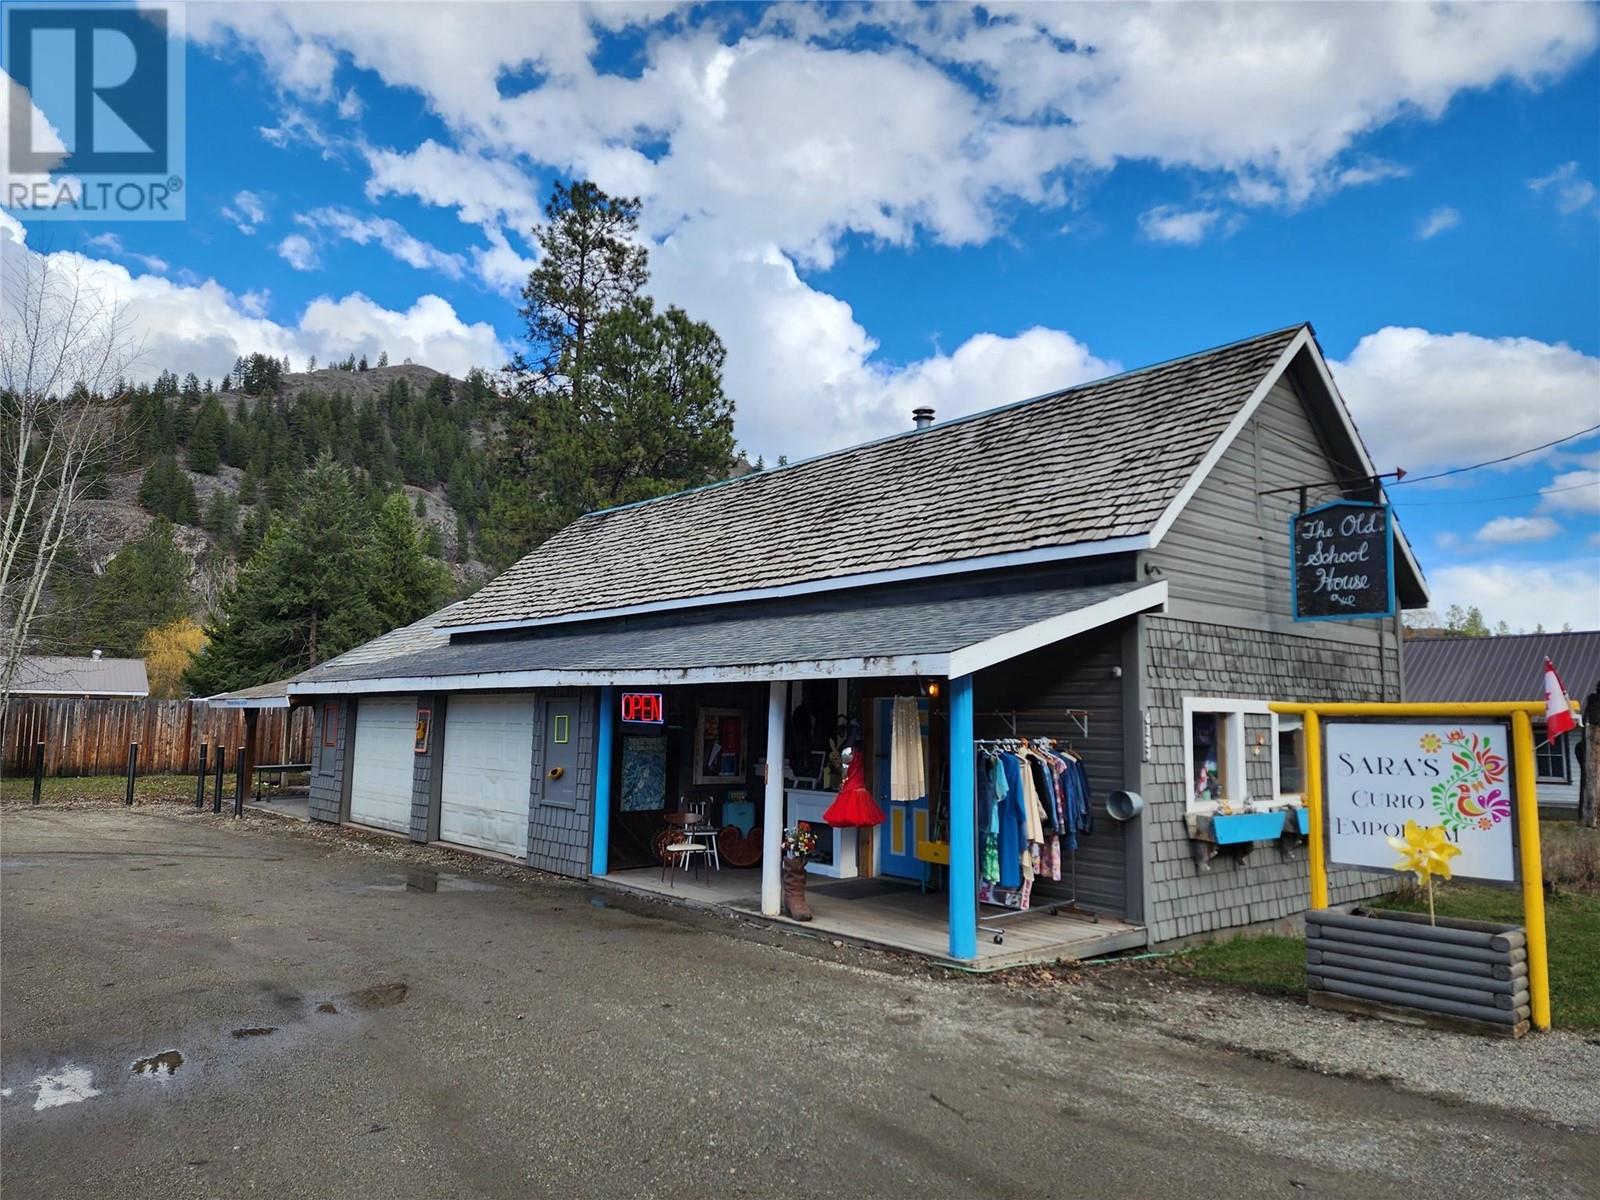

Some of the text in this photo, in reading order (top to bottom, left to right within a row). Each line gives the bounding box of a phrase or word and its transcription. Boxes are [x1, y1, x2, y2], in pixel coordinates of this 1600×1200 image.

[1302, 513, 1377, 539] The Old
[1304, 540, 1369, 566] School
[1313, 567, 1370, 592] House
[623, 695, 662, 721] OPEN
[1337, 752, 1440, 777] SARA'S
[1351, 789, 1425, 810] CURIO
[1336, 817, 1459, 843] EMPOM
